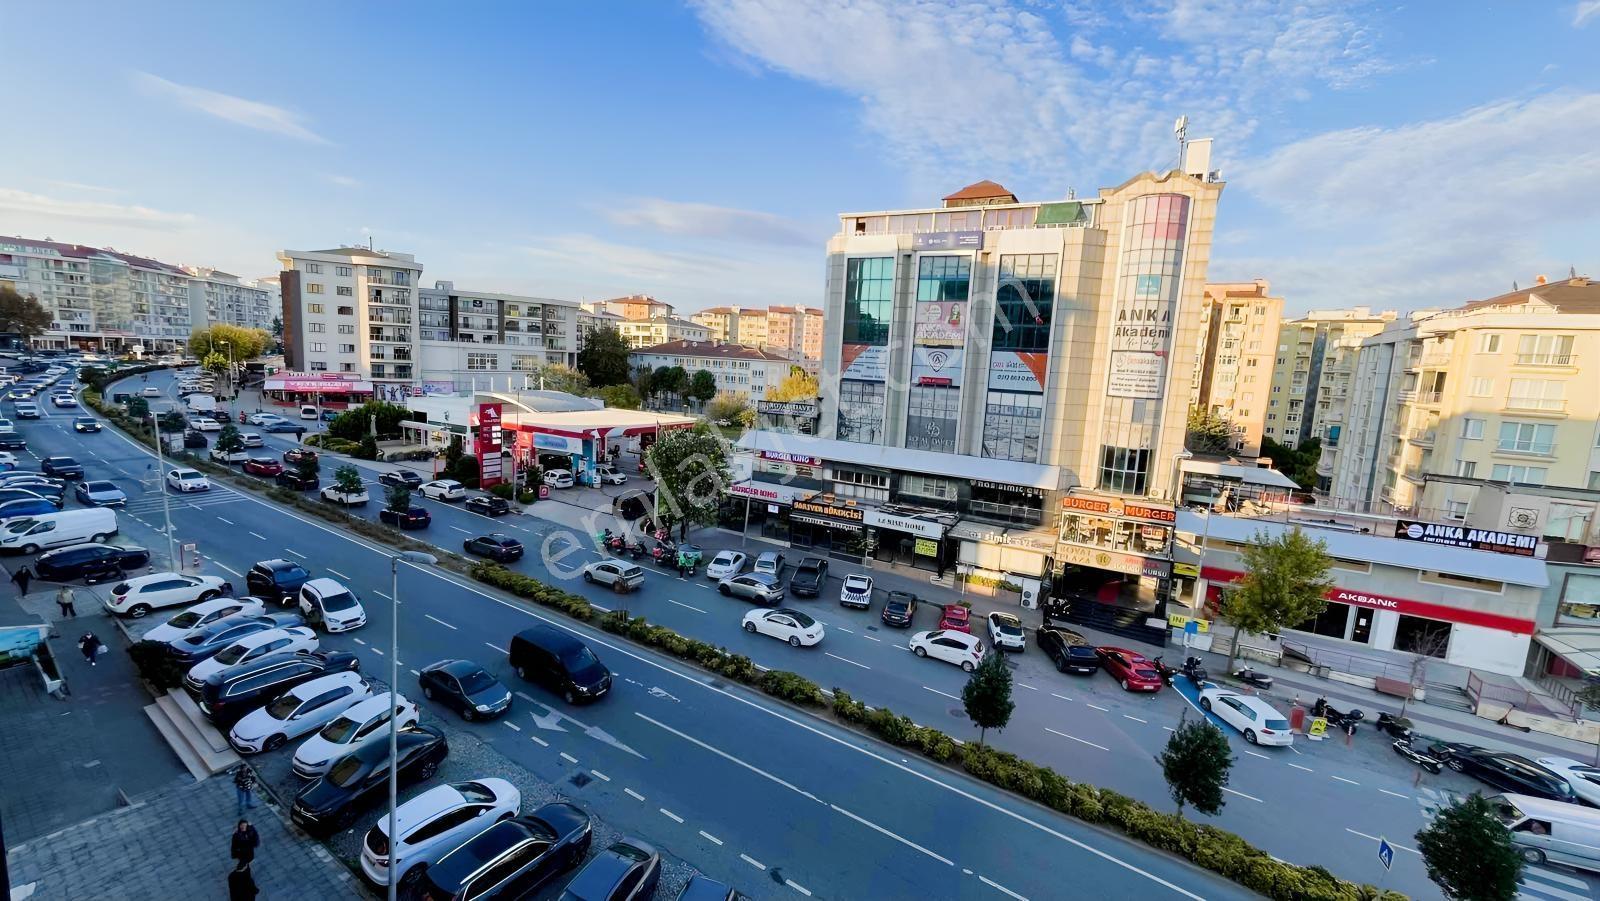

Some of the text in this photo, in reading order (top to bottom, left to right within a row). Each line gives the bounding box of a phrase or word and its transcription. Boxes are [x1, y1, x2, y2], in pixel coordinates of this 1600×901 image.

[1118, 308, 1171, 323] ANKA
[766, 450, 810, 464] BURGER KING
[731, 485, 778, 498] BURGER KING
[1063, 497, 1175, 521] BURGER MURGER
[984, 531, 1011, 544] simit
[1425, 524, 1464, 540] ANKA
[1338, 592, 1398, 608] AKBANK
